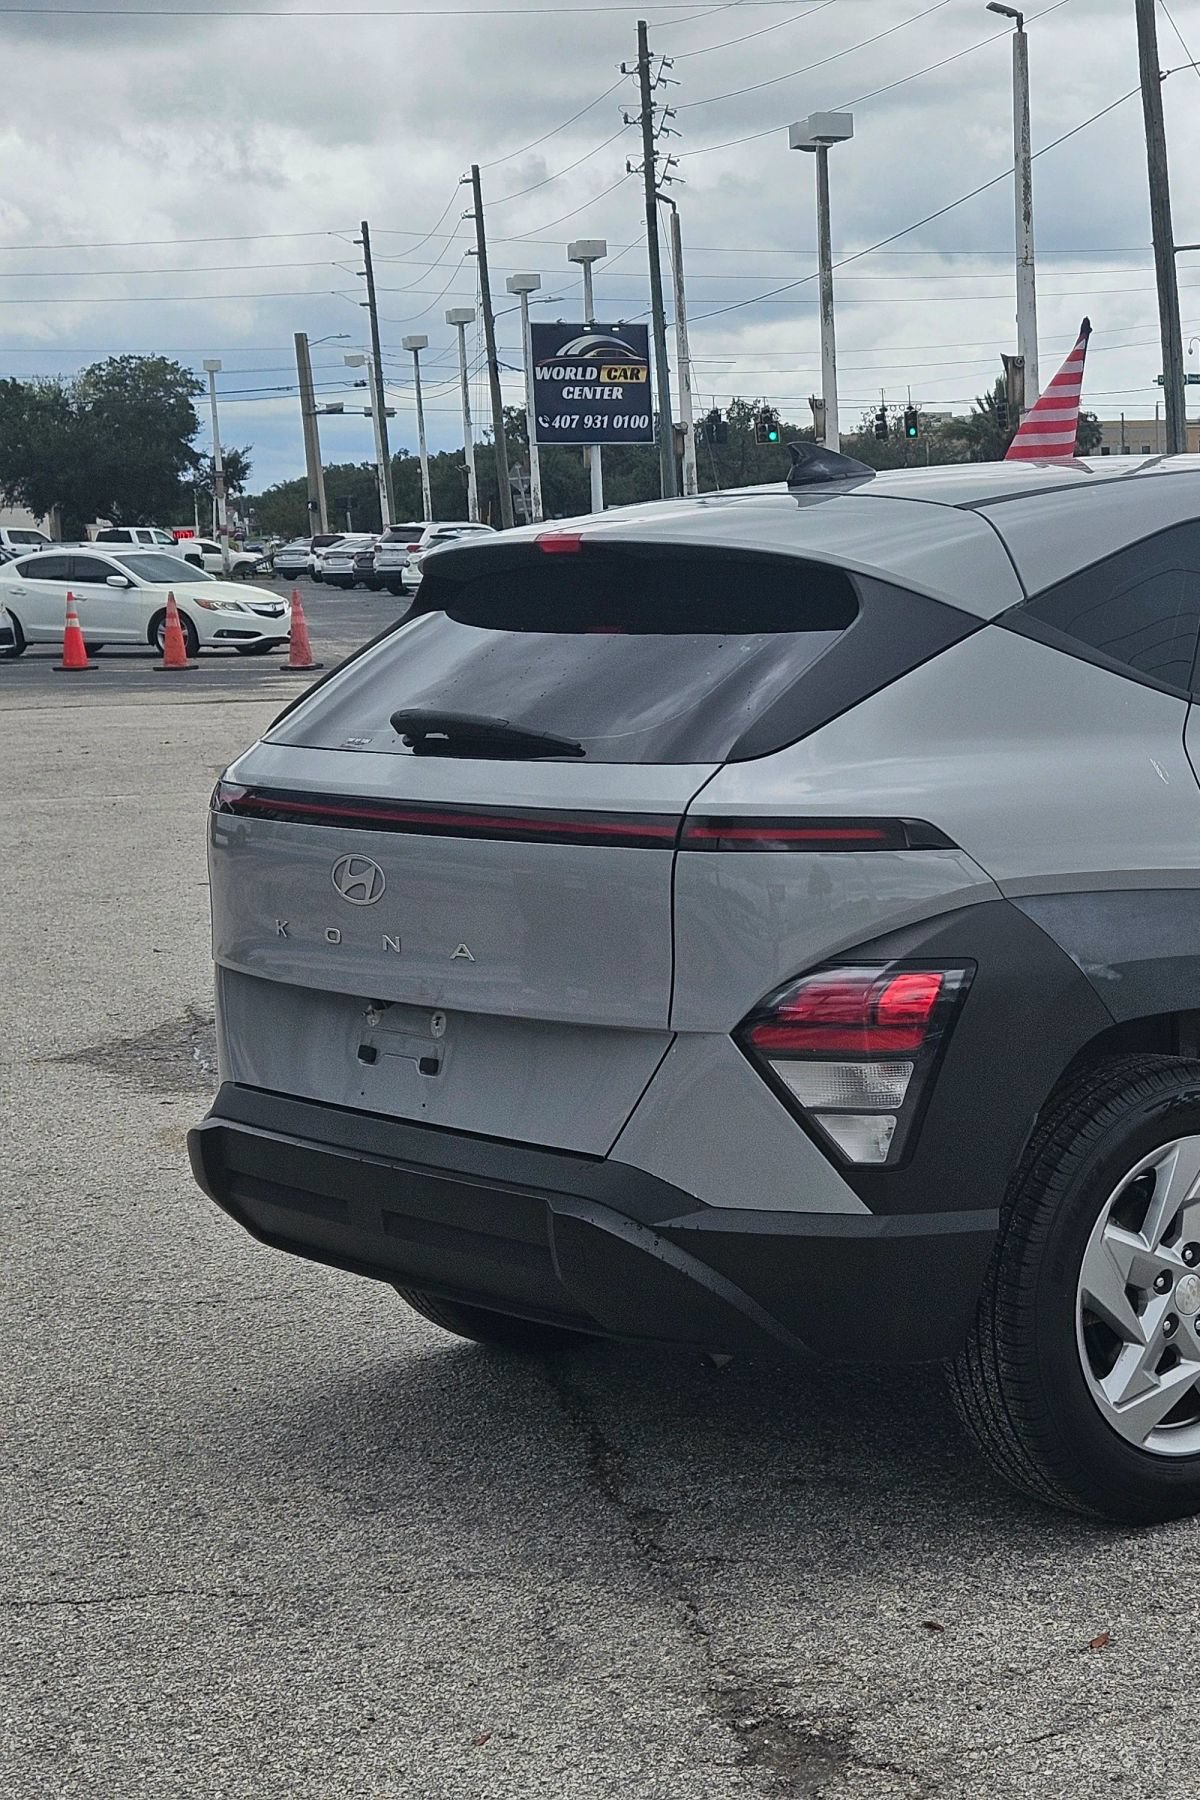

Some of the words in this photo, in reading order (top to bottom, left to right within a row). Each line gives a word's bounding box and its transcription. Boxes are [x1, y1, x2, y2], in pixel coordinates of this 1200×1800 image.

[535, 366, 598, 381] WORLD
[606, 366, 641, 381] CAR
[562, 386, 623, 400] CENTER
[551, 414, 580, 429] 407
[583, 414, 609, 429] 931
[613, 414, 649, 429] 0100
[275, 919, 476, 962] KONA
